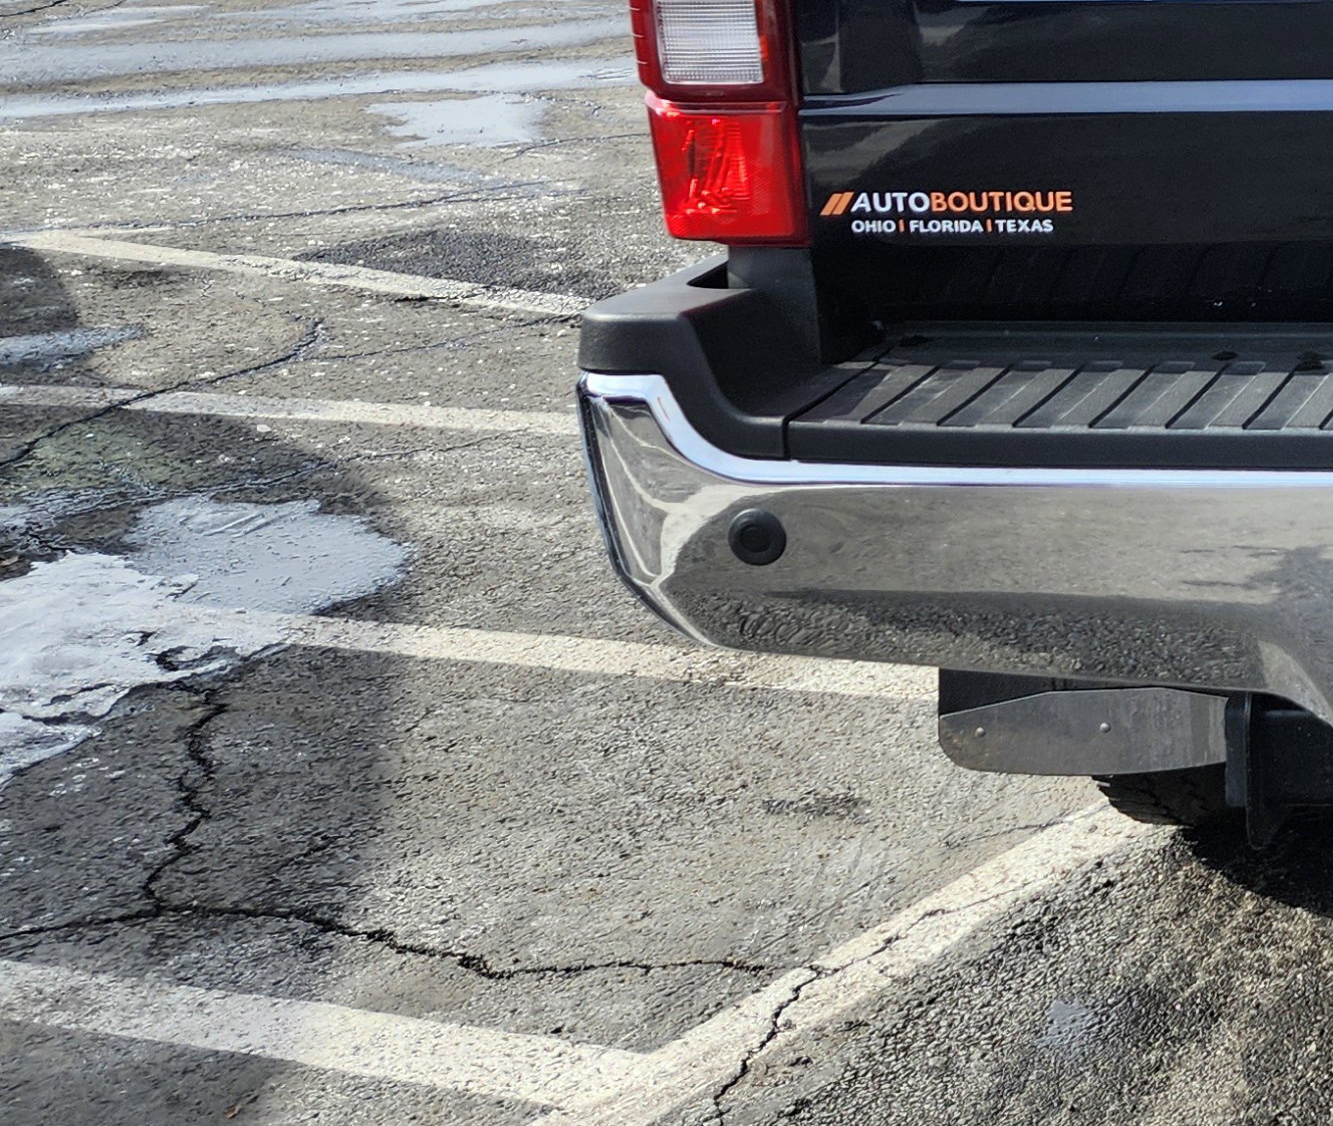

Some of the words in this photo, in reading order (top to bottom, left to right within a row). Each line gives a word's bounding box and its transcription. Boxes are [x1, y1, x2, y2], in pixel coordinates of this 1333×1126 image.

[851, 191, 1073, 213] AUTOBOUTIQUE
[851, 220, 896, 233] OHIO
[909, 219, 984, 233] FLORIDA
[995, 219, 1053, 232] TEXAS
